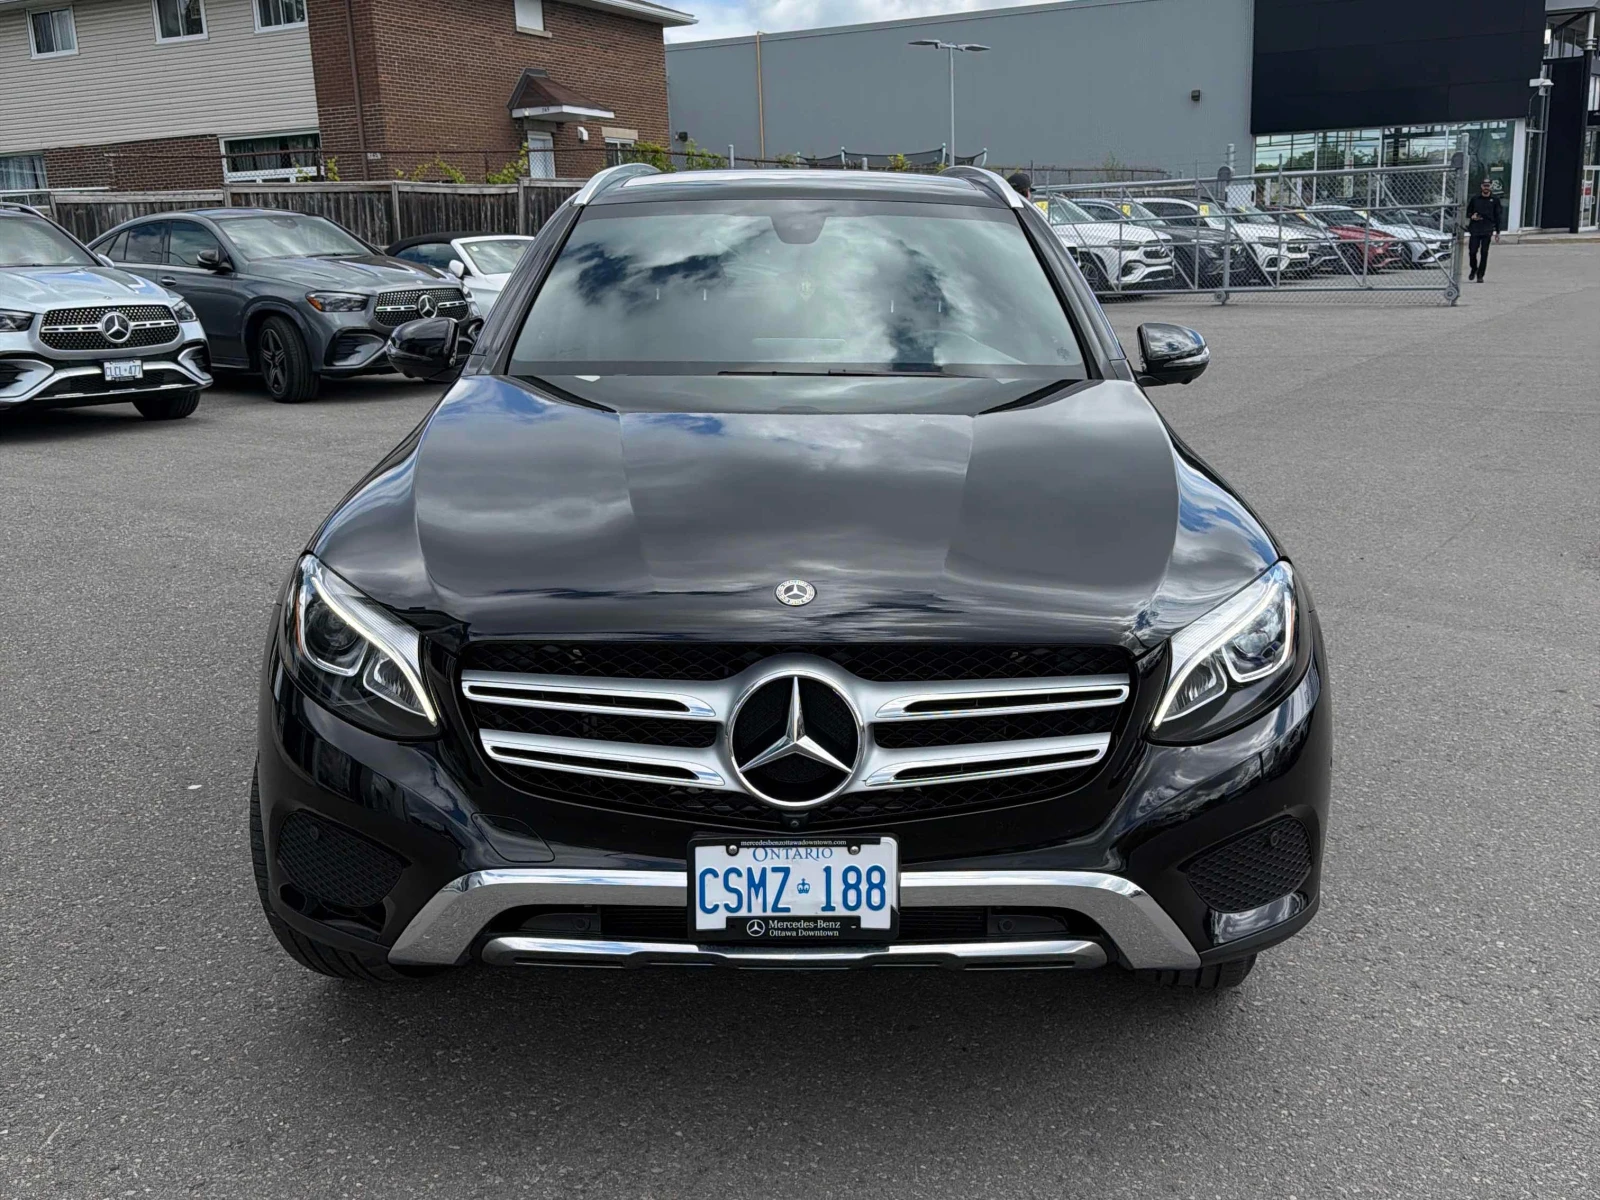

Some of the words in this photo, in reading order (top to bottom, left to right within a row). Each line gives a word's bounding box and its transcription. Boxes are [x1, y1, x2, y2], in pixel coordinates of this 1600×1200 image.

[753, 847, 833, 862] ONTARIO
[699, 866, 791, 914] CSMZ
[821, 865, 886, 912] 188
[768, 920, 841, 929] Mercedes-Benz
[769, 929, 797, 937] Ottawa
[798, 929, 839, 937] Downtown
